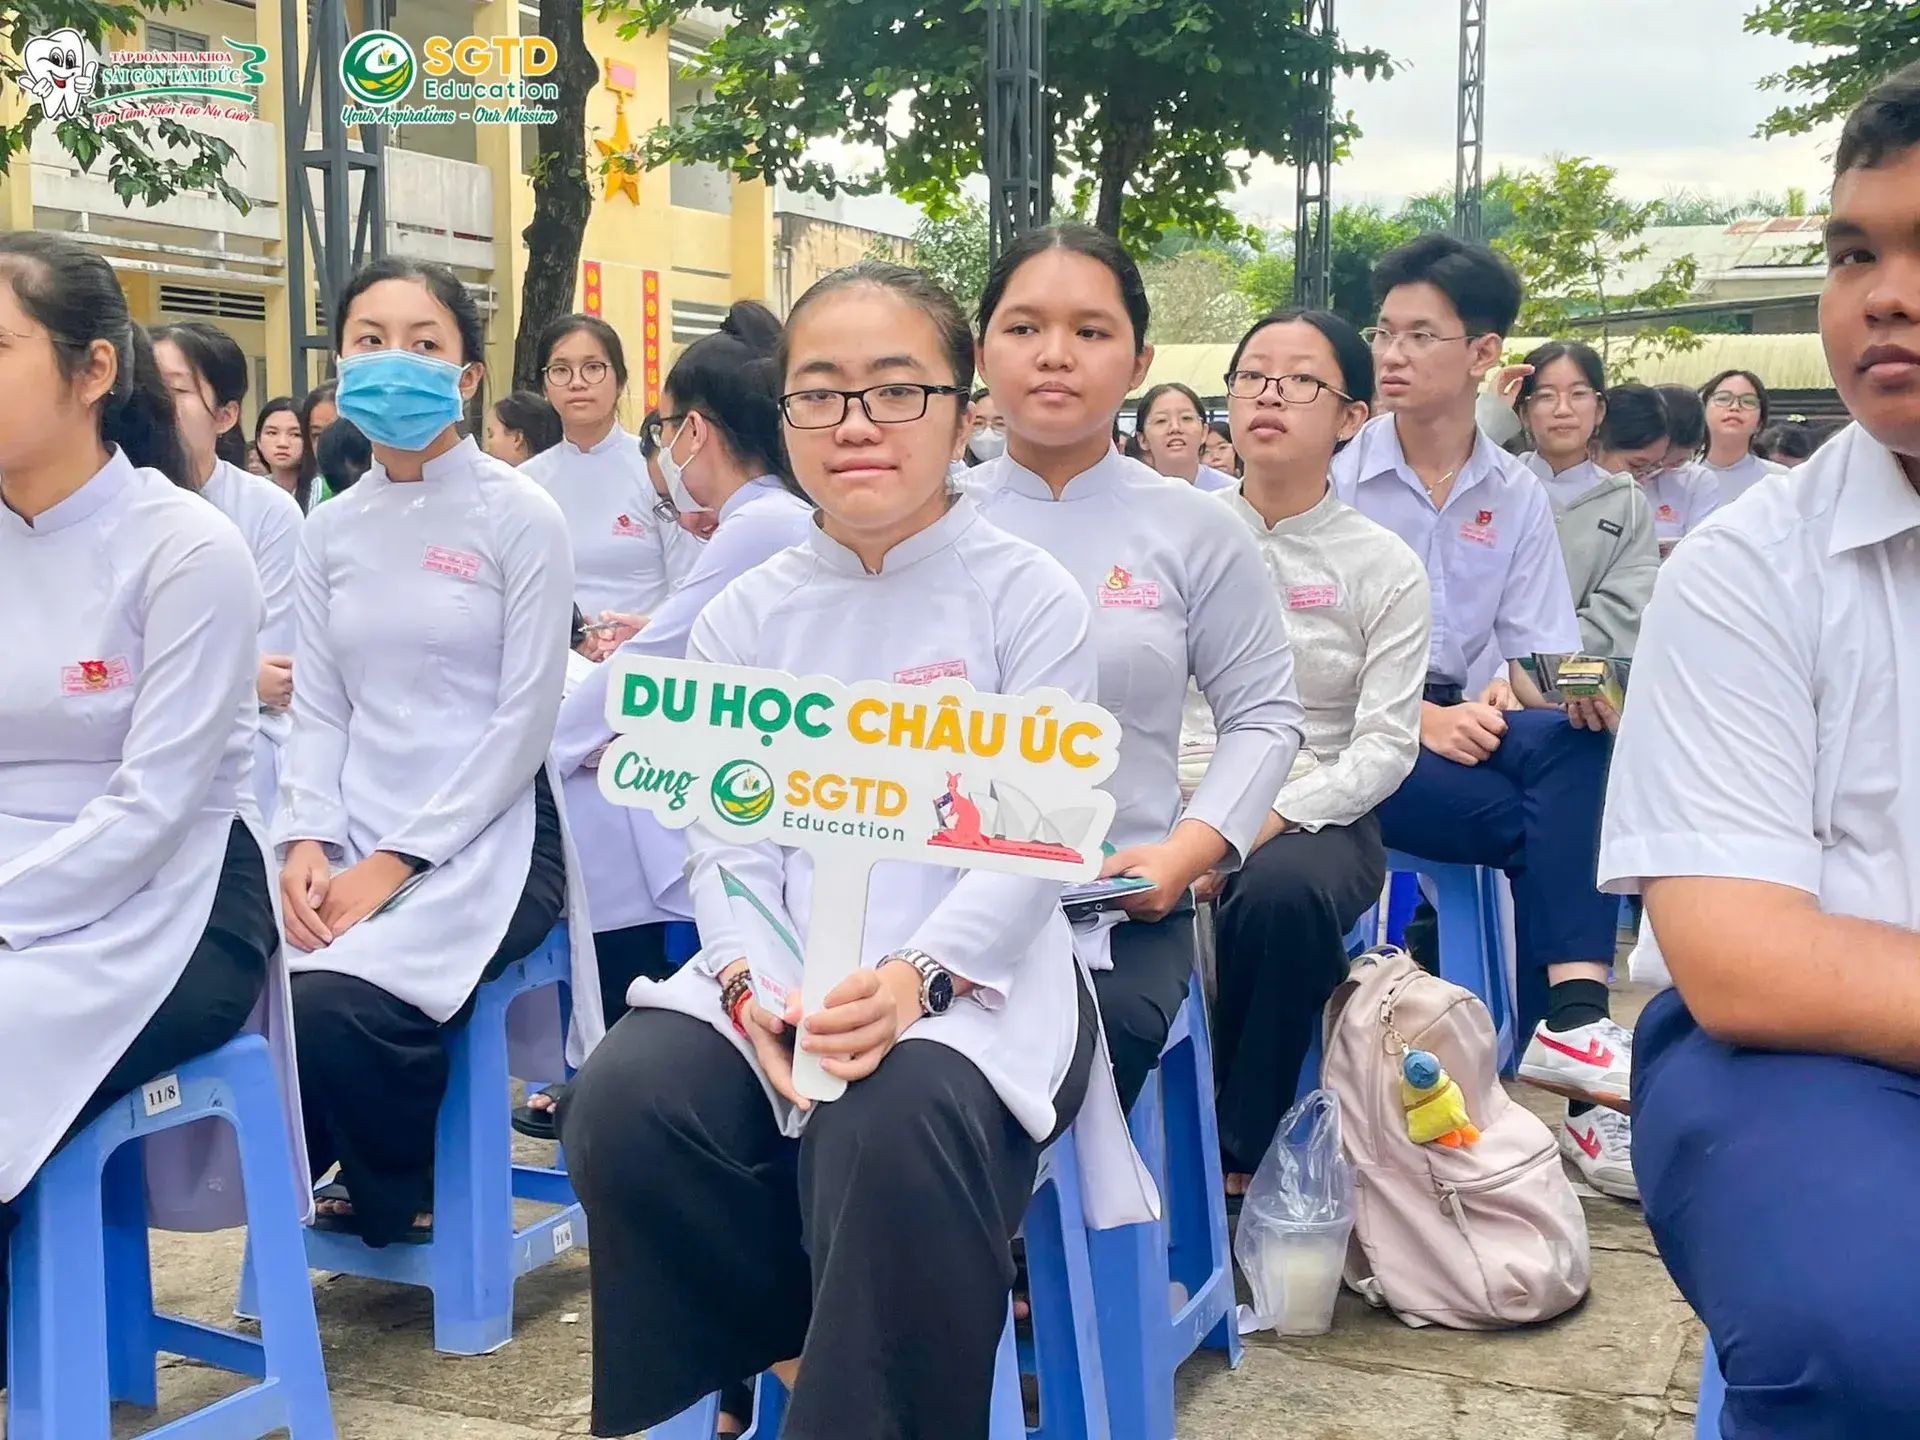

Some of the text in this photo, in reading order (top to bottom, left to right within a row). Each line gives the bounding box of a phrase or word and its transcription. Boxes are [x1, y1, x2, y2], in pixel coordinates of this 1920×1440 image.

[621, 673, 1104, 769] DU HỌC CHÂU ÚC
[613, 751, 701, 812] Cùng
[784, 769, 909, 817] SGTD
[782, 811, 906, 843] Education
[149, 1084, 176, 1106] 11/8
